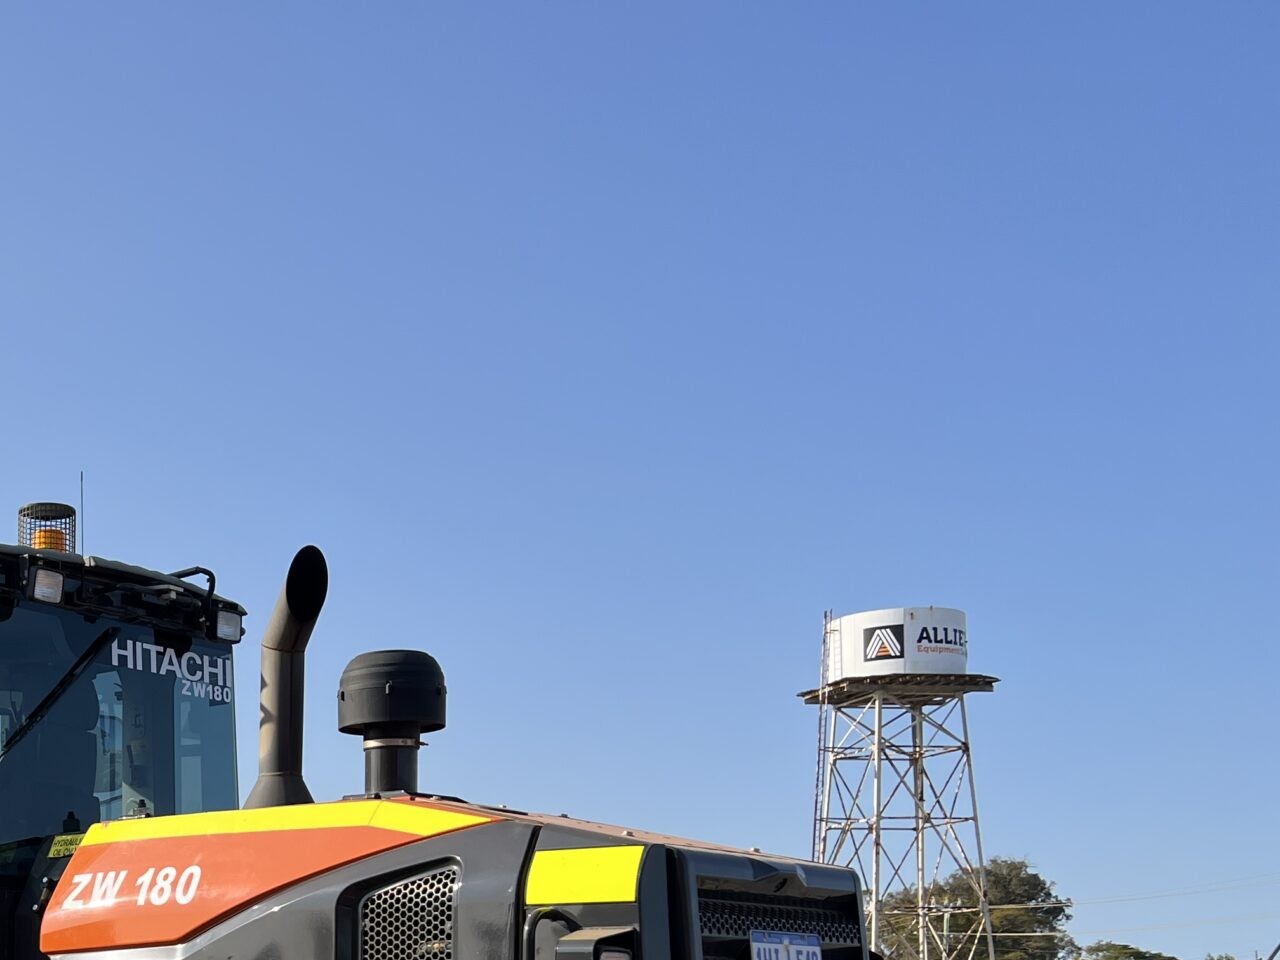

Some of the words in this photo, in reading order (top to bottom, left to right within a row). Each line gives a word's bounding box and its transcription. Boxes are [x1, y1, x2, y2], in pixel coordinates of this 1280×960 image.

[111, 637, 232, 688] HITACHI
[181, 680, 232, 703] ZW180
[62, 869, 128, 911] ZW
[135, 864, 202, 907] 180
